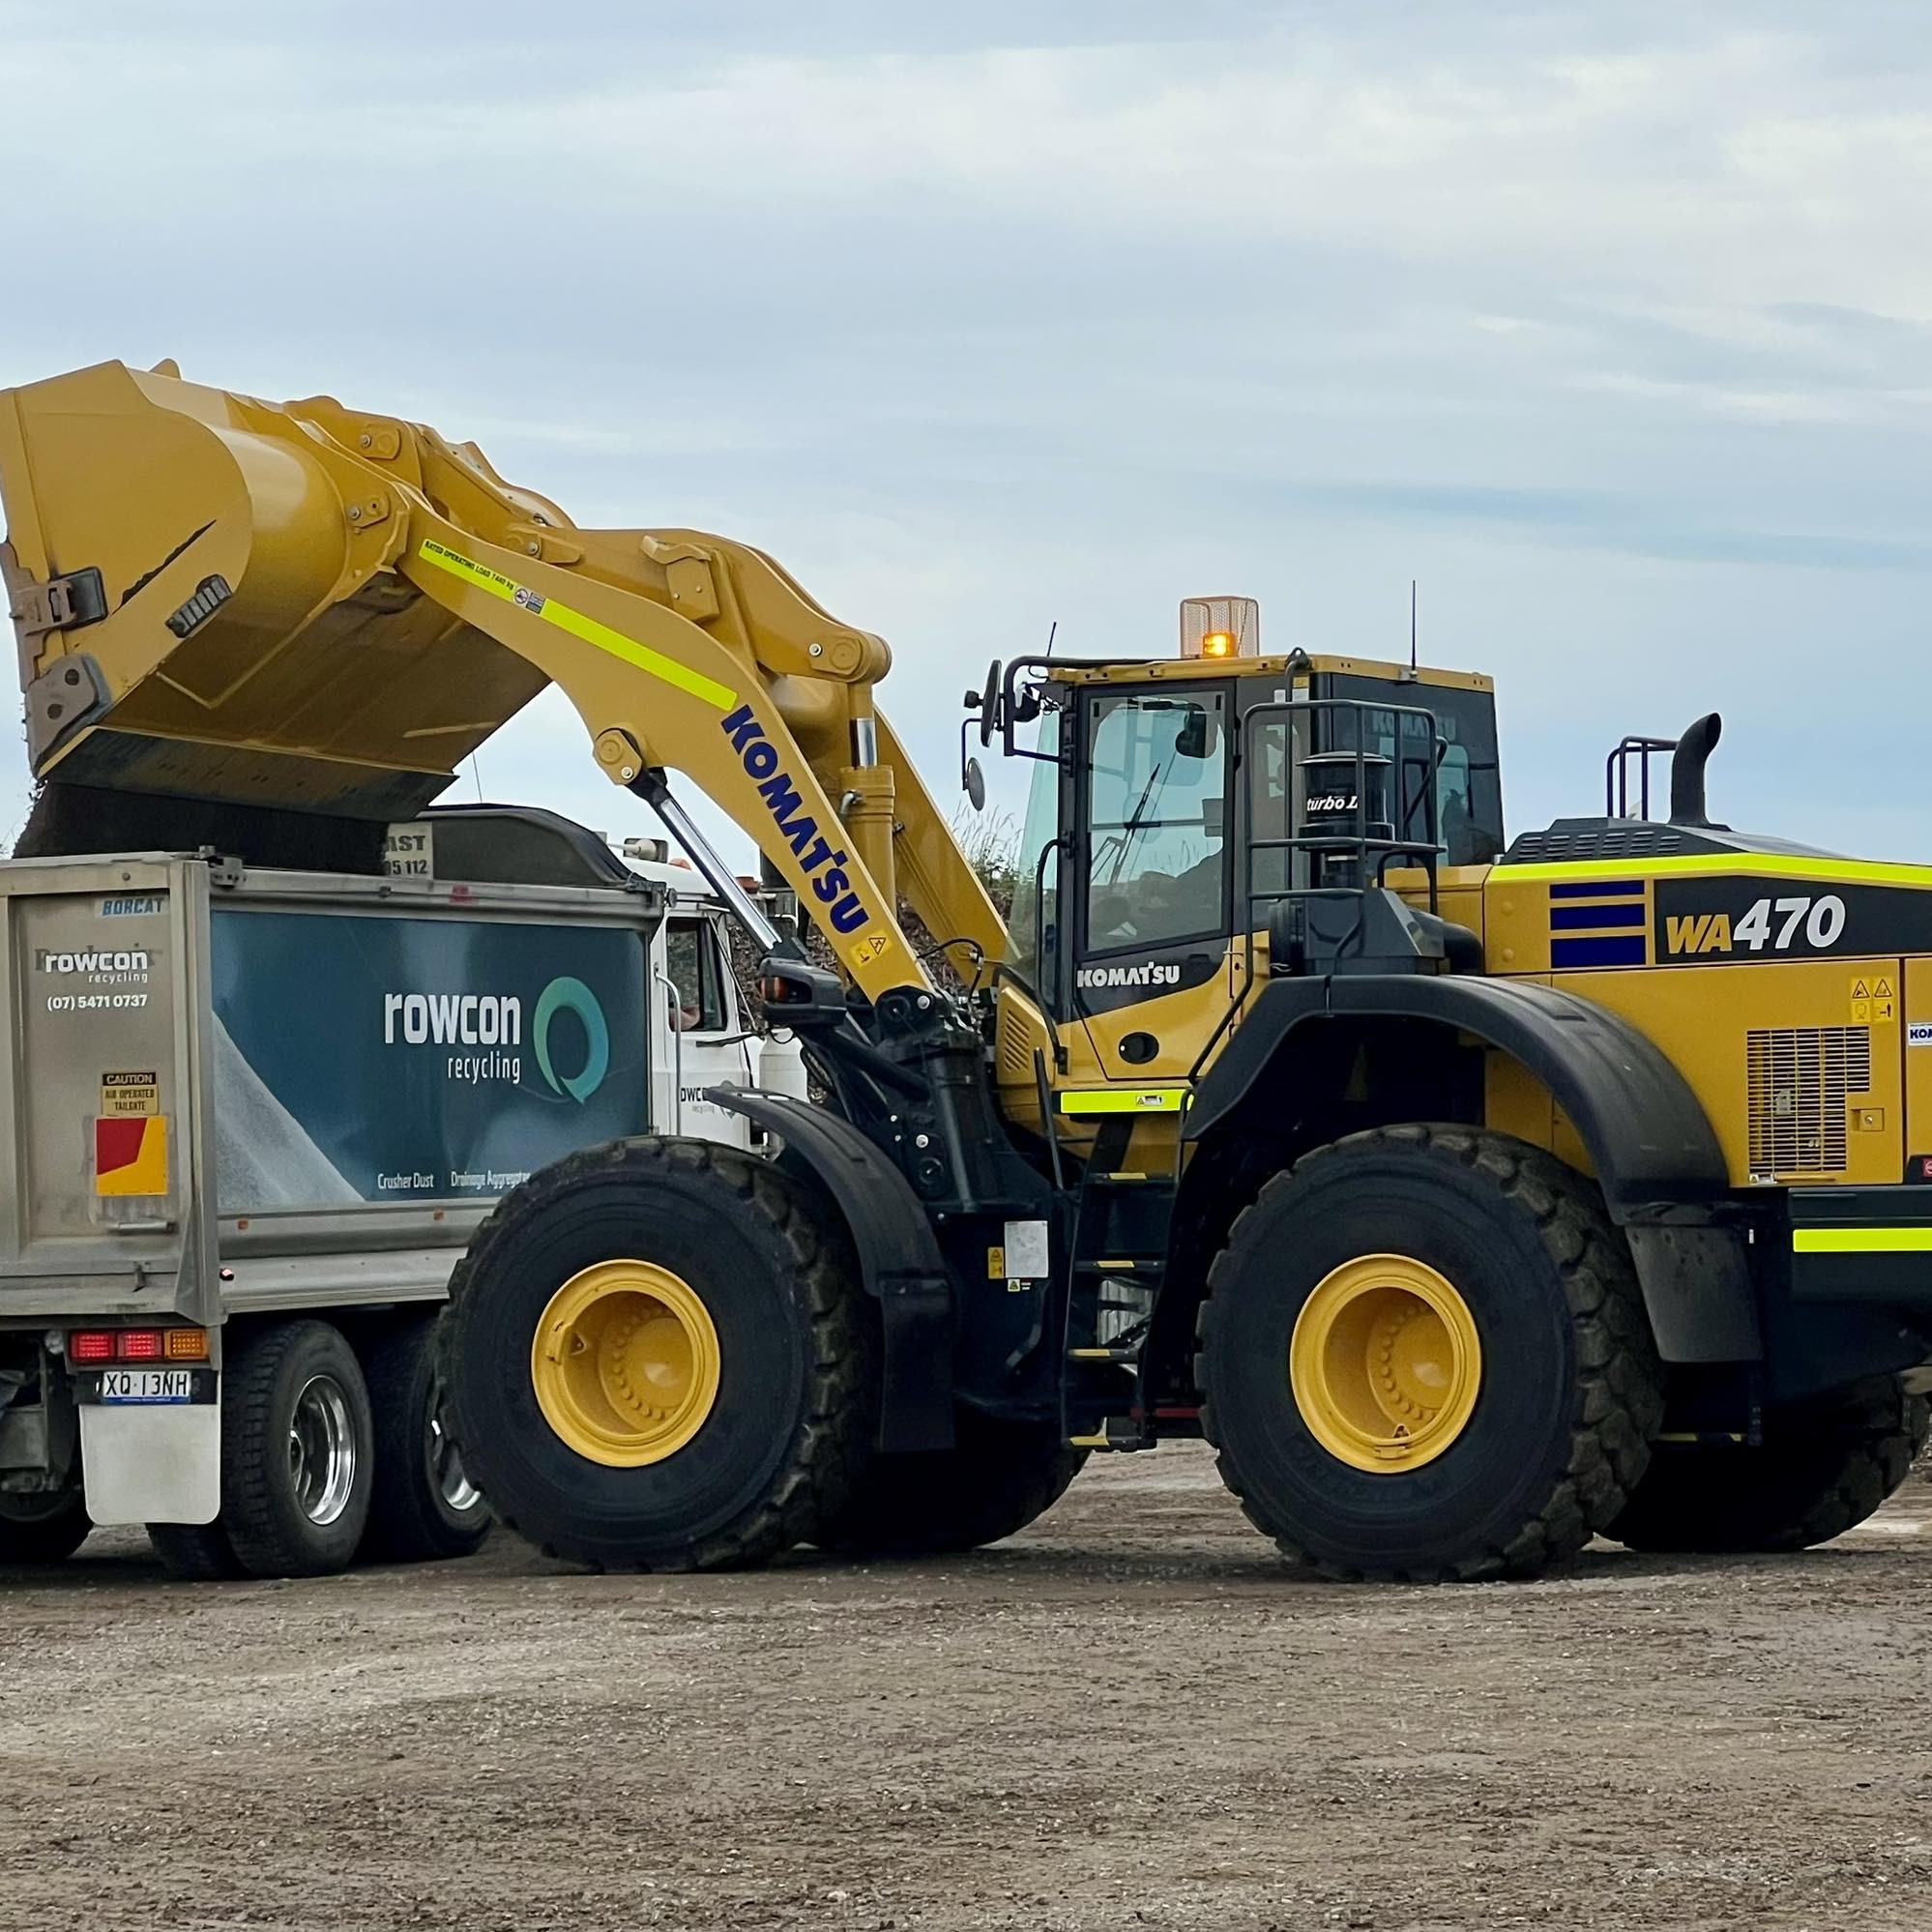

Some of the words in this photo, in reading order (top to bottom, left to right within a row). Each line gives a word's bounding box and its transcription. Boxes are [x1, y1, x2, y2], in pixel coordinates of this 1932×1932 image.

[1306, 795, 1345, 811] turbo
[721, 704, 869, 933] KOMATSU
[404, 860, 427, 874] 112
[45, 951, 148, 973] rowcon
[88, 972, 148, 984] recycling
[1076, 961, 1180, 987] KOMATSU
[47, 996, 75, 1011] (07)
[77, 995, 110, 1009] 5471
[113, 994, 148, 1008] 0737
[385, 993, 521, 1045] rowcon
[448, 1050, 520, 1085] recycling
[106, 1073, 153, 1085] CAUTION
[377, 1173, 411, 1189] Crusher
[413, 1172, 434, 1188] Dust
[451, 1170, 485, 1190] Drainage
